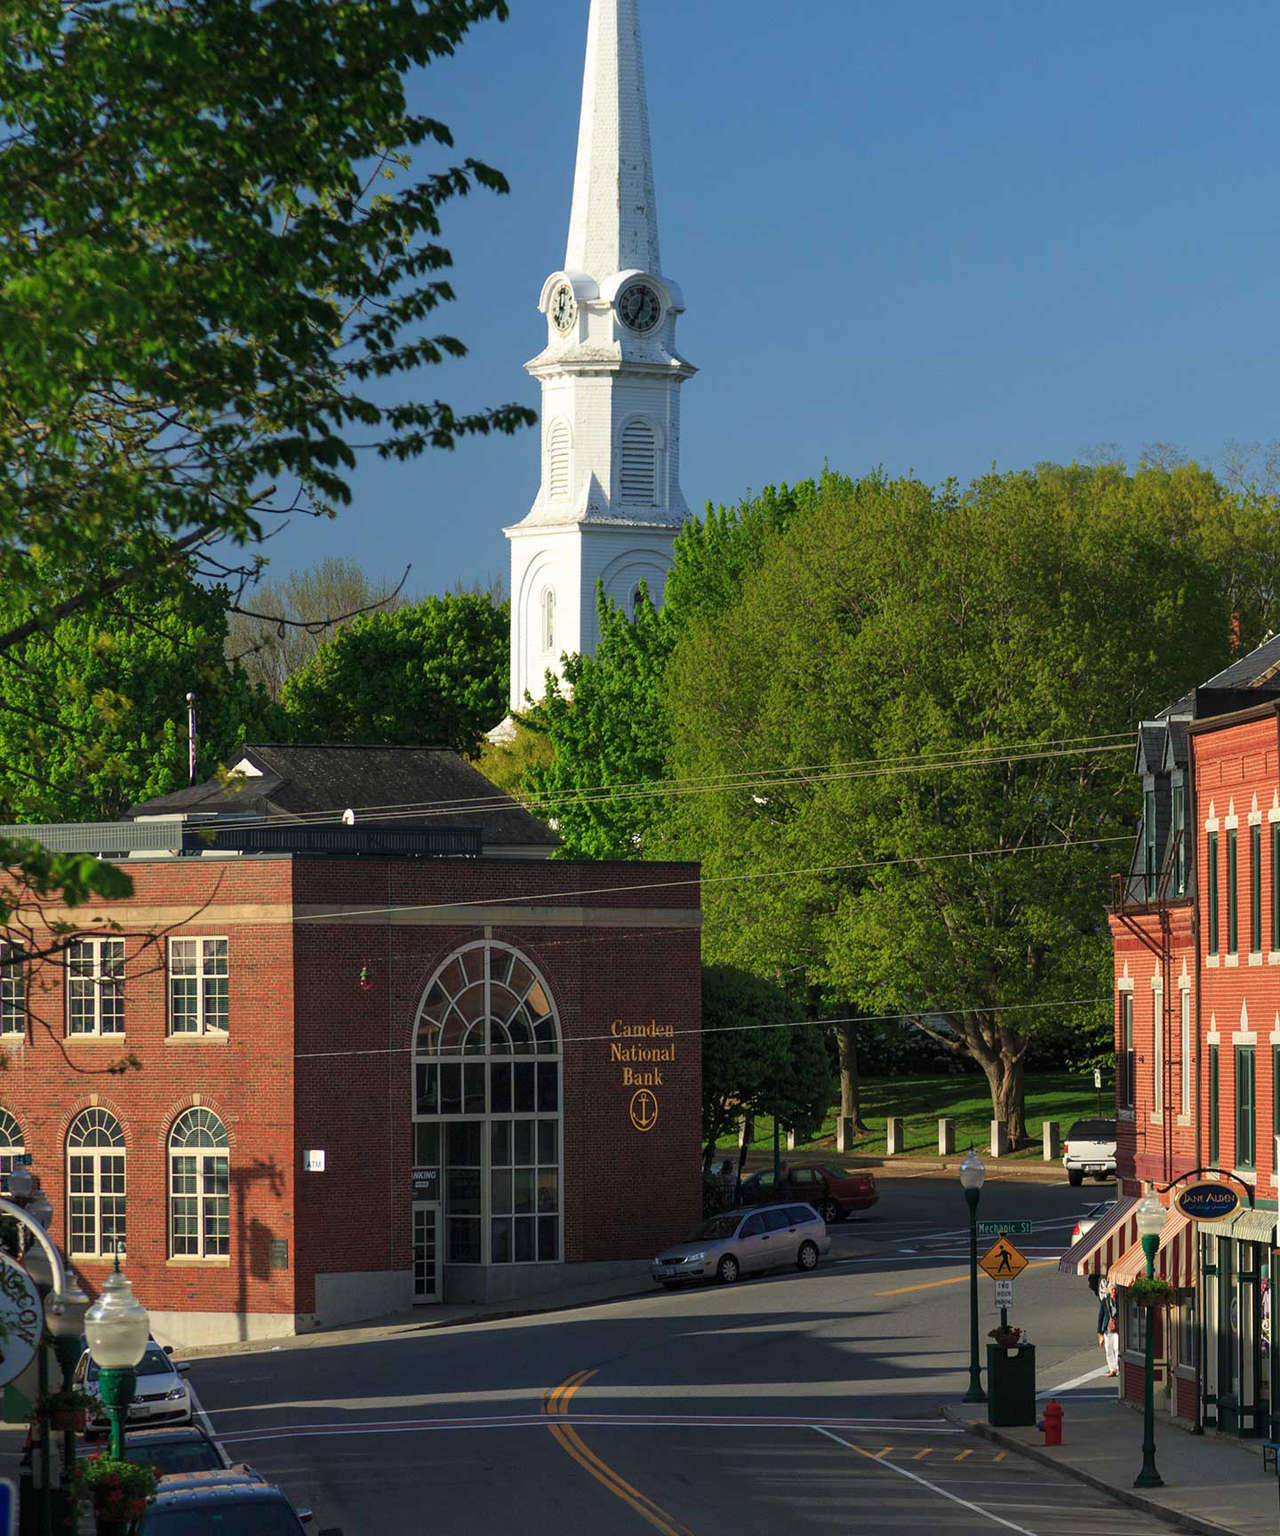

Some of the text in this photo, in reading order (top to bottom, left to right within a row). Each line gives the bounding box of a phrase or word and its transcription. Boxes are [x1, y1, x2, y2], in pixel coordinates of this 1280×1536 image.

[611, 1019, 674, 1038] Camden
[611, 1043, 675, 1061] National
[623, 1067, 663, 1086] Bank
[306, 1160, 321, 1169] ATM
[411, 1170, 437, 1180] NKING
[978, 1222, 1030, 1233] Mechanic St
